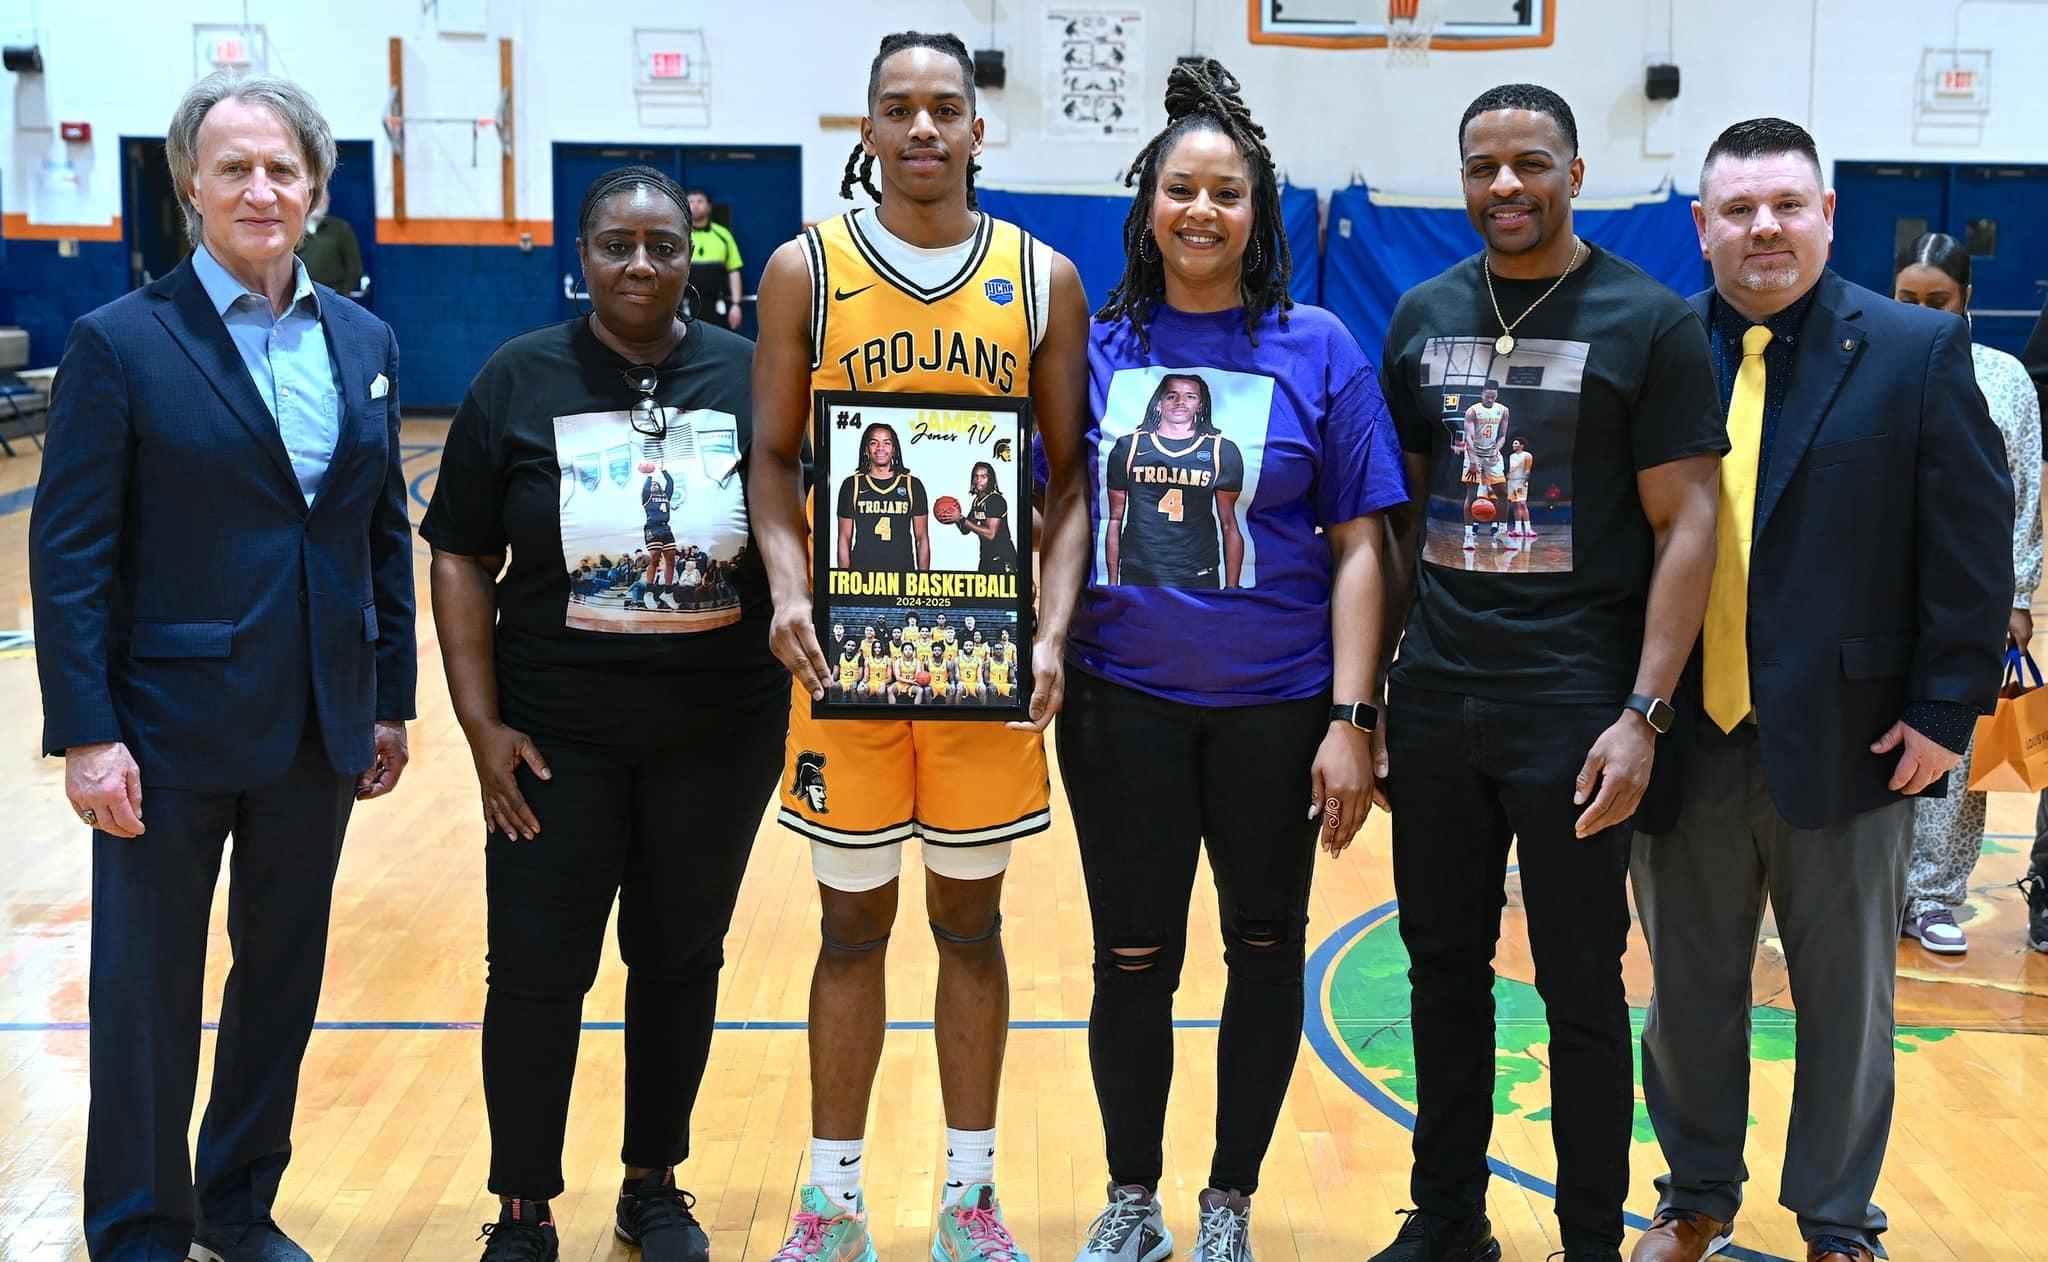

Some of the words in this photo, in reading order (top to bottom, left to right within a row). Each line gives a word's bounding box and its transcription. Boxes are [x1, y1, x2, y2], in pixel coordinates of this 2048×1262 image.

[654, 52, 683, 76] EXIT
[1945, 71, 1974, 90] EXIT
[839, 328, 1017, 394] TROJANS
[836, 411, 862, 430] #4
[909, 410, 993, 433] JAMES
[1132, 465, 1212, 487] TROJANS
[857, 500, 909, 514] TROJANS
[1157, 488, 1185, 522] 4
[874, 516, 892, 541] 4
[829, 570, 900, 596] TROJAN
[906, 572, 1018, 598] BASKETBALL
[896, 597, 951, 607] 2024-2025
